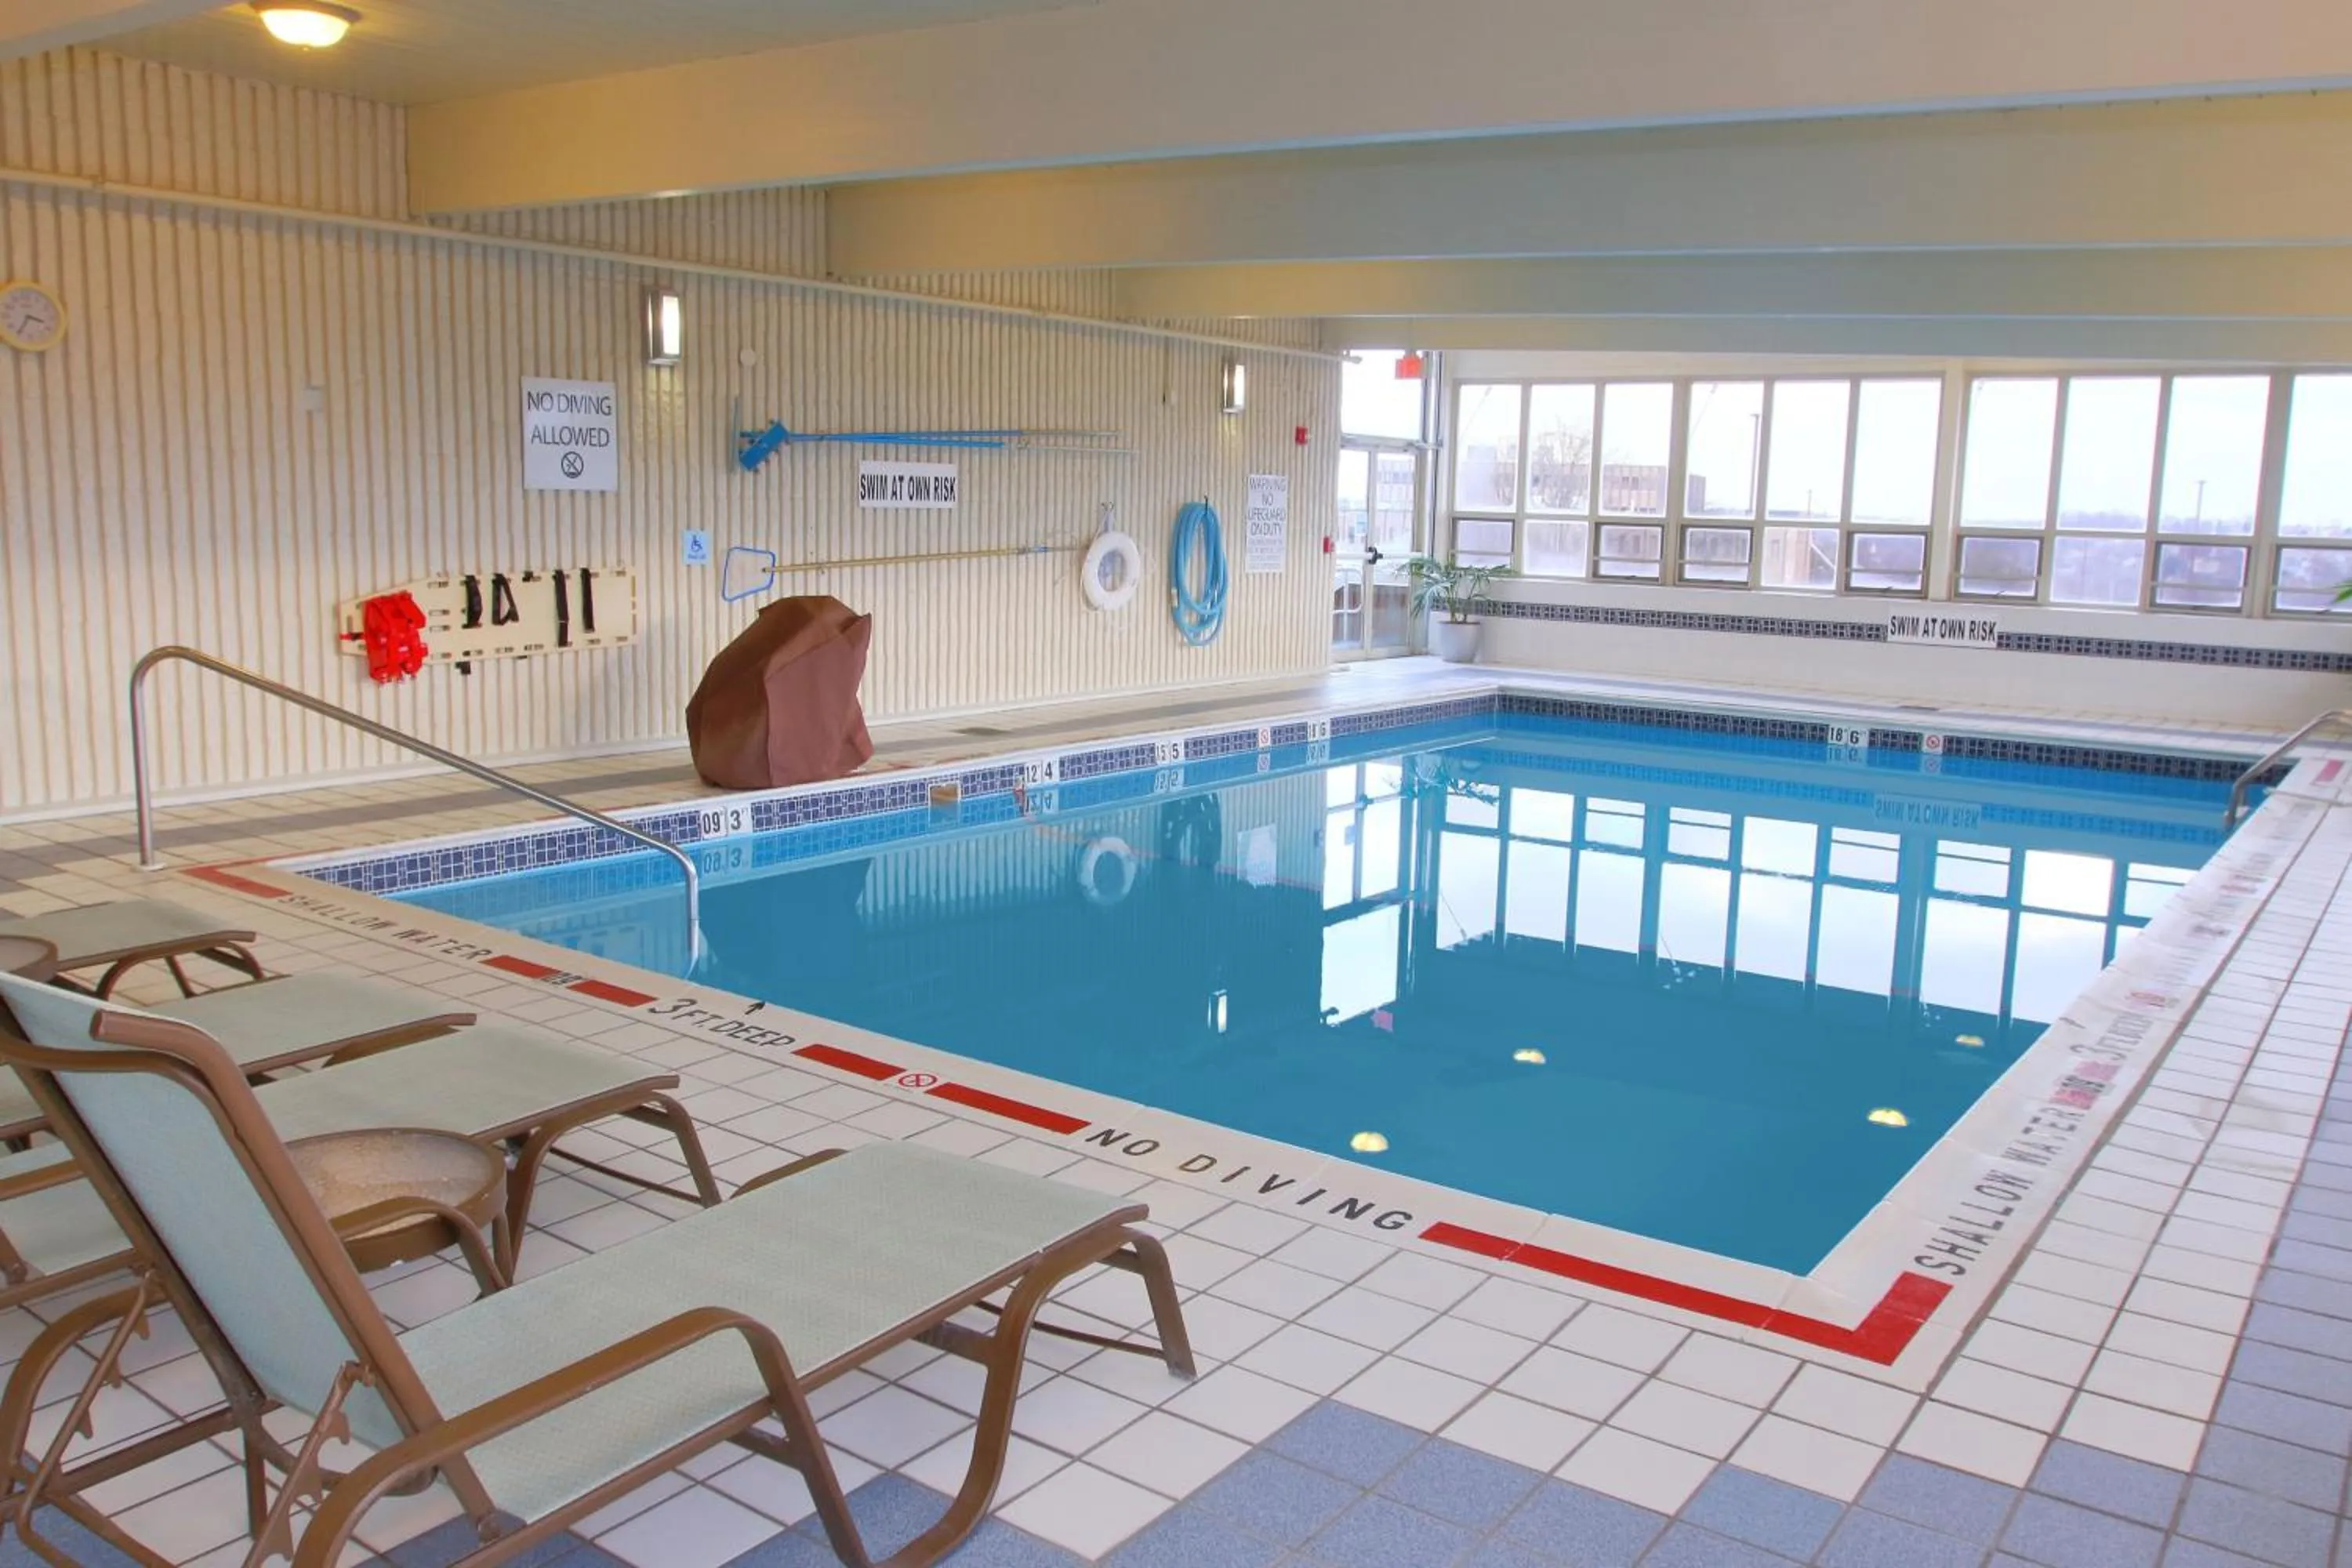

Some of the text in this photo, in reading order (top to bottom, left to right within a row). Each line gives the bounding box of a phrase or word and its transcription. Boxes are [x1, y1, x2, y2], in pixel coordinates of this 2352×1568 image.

[527, 390, 612, 416] NO DIVING
[531, 425, 610, 448] ALLOWED
[860, 474, 956, 502] SWIM AT OWN RISK
[1262, 493, 1274, 506] NO
[1264, 522, 1283, 536] DUTY
[1890, 615, 1998, 641] SWIM AT OWN RISK
[1044, 760, 1053, 780] 4
[391, 928, 492, 960] WATER
[647, 998, 698, 1014] 3
[709, 1020, 796, 1047] DEEP
[1085, 1128, 1413, 1230] NO DIVING
[1914, 1169, 2034, 1276] SHALLOW
[1999, 1107, 2085, 1167] WATER
